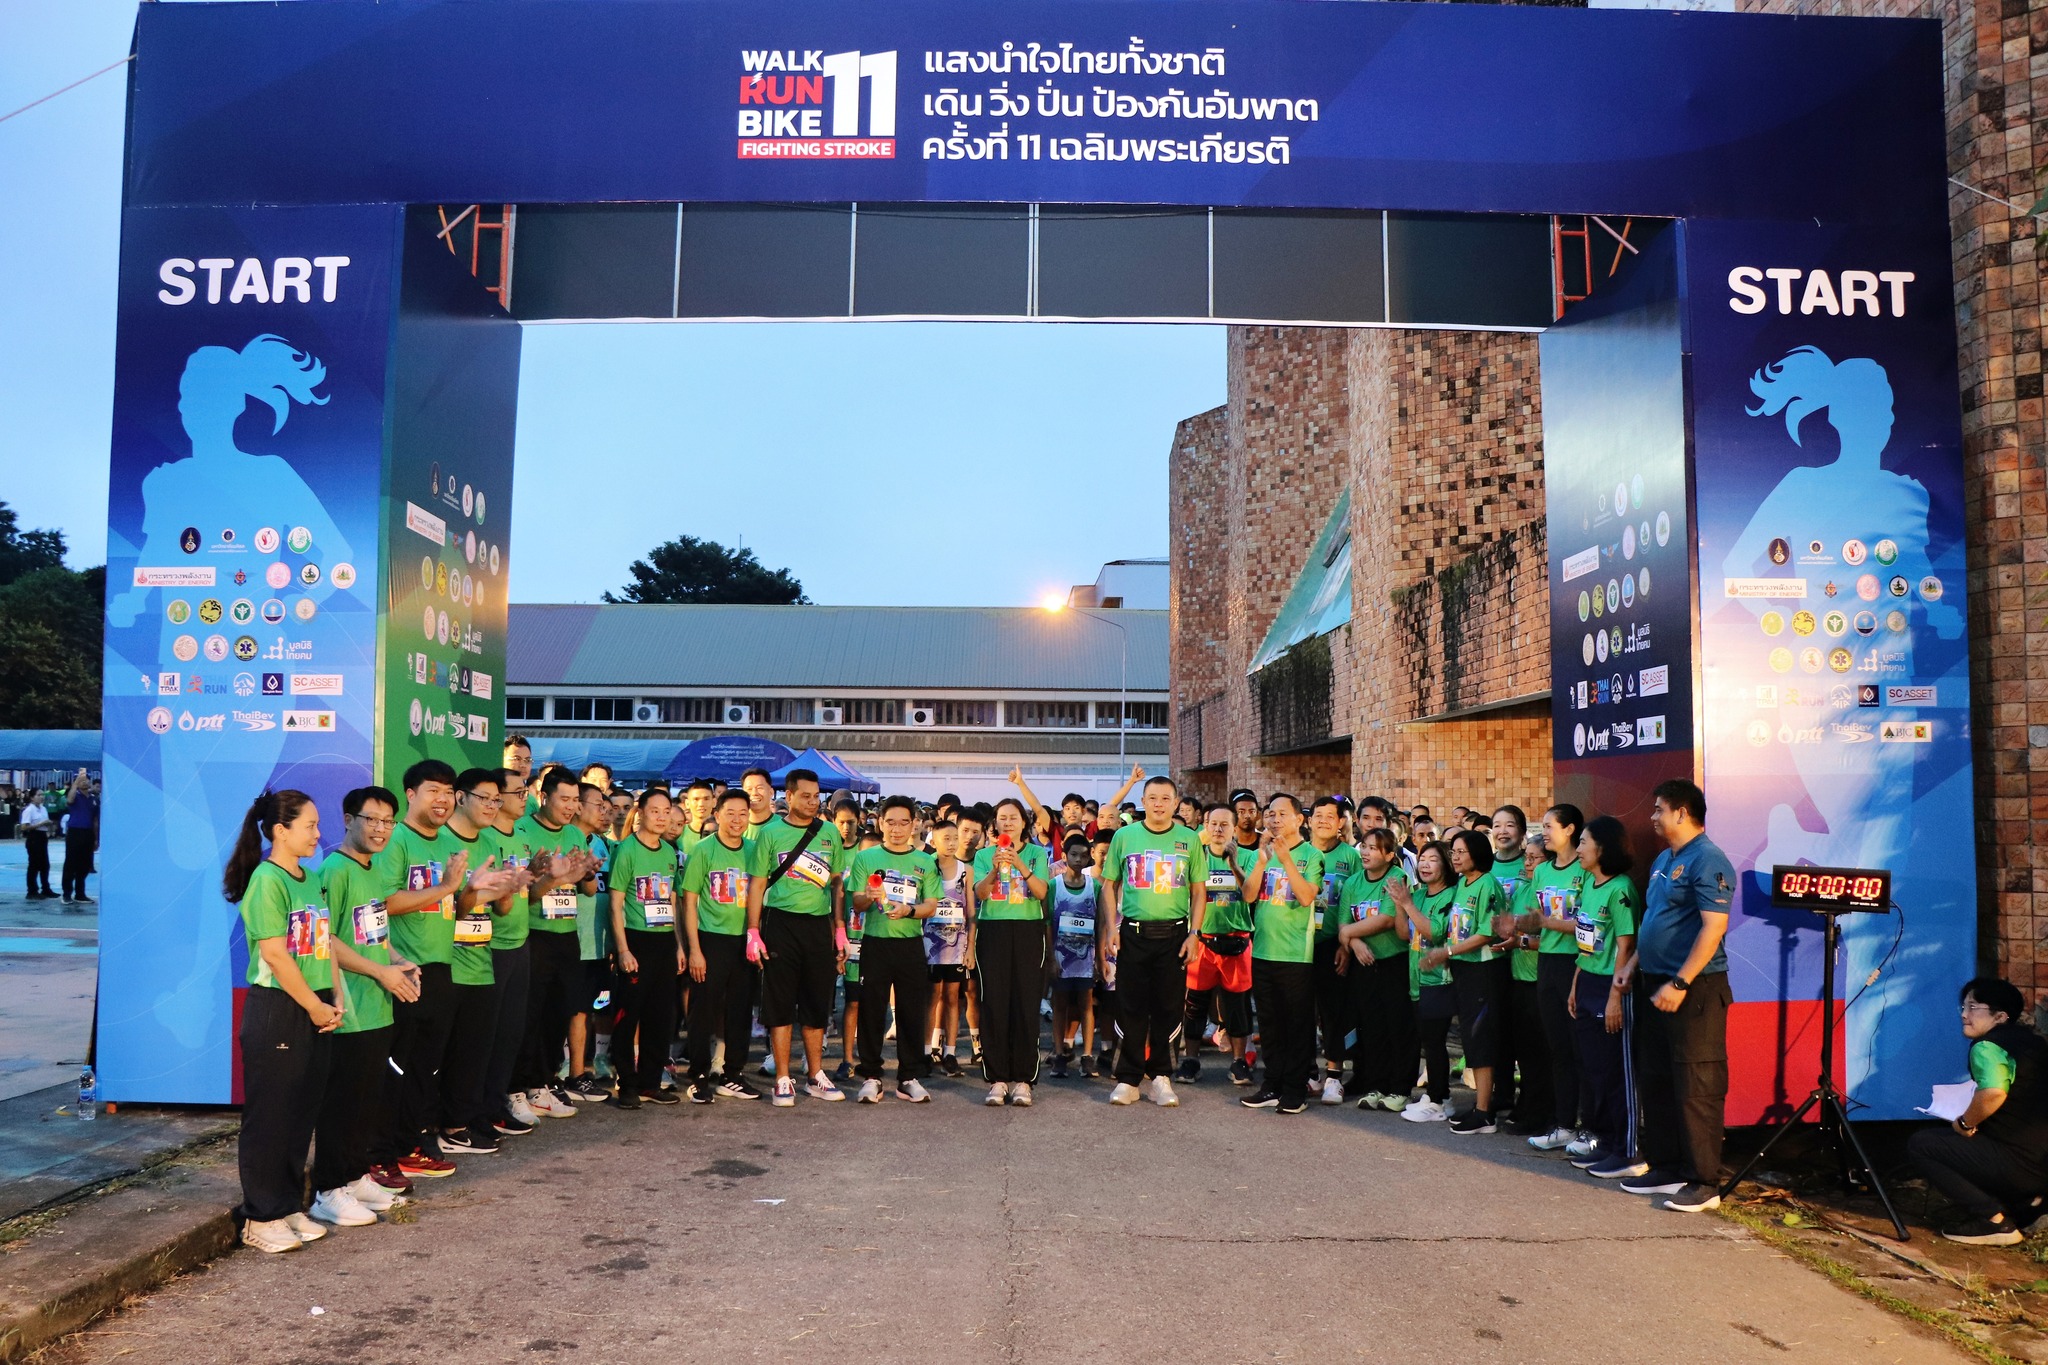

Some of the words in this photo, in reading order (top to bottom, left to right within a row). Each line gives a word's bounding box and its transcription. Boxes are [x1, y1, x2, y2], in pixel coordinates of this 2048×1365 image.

[741, 50, 824, 72] WALK
[924, 36, 1225, 76] แสงนำใจไทยทั้งชาติ
[739, 75, 824, 105] RUN
[823, 50, 898, 137] 11
[923, 87, 982, 117] เดิน
[990, 80, 1030, 117] วิ่ง
[1037, 79, 1084, 117] ปั่น
[1092, 86, 1319, 122] ป้องกันอัมพาต
[737, 109, 823, 137] BIKE
[742, 142, 821, 156] FIGHTING
[824, 142, 892, 156] STROKE
[922, 121, 1009, 161] ครั้งที่
[1016, 134, 1041, 160] 11
[1049, 132, 1290, 165] เฉลิมพระเกียรติ
[158, 256, 351, 306] START
[1728, 266, 1916, 318] START
[289, 640, 313, 651] มูลนิธิ
[285, 649, 313, 660] ไทยคม
[294, 677, 308, 686] SC
[309, 677, 340, 686] ASSET
[1641, 672, 1649, 686] SC
[1649, 669, 1666, 684] ASSET
[204, 684, 228, 694] RUN
[1889, 689, 1903, 698] SC
[1904, 689, 1933, 698] ASSET
[232, 711, 275, 720] ThaiBev
[299, 717, 316, 727] BJC
[195, 713, 227, 732] ptt
[1611, 721, 1634, 734] ThaiBev
[1831, 722, 1873, 731] ThaiBev
[1594, 727, 1610, 751] ptt
[1794, 726, 1825, 744] ptt
[1896, 728, 1913, 738] BJC
[807, 862, 823, 876] 350
[1212, 877, 1224, 885] 69
[1782, 873, 1883, 898] 00:00:00
[892, 886, 904, 894] 66
[554, 898, 570, 907] 190
[656, 907, 668, 915] 372
[938, 909, 954, 917] 464
[472, 924, 482, 933] 72
